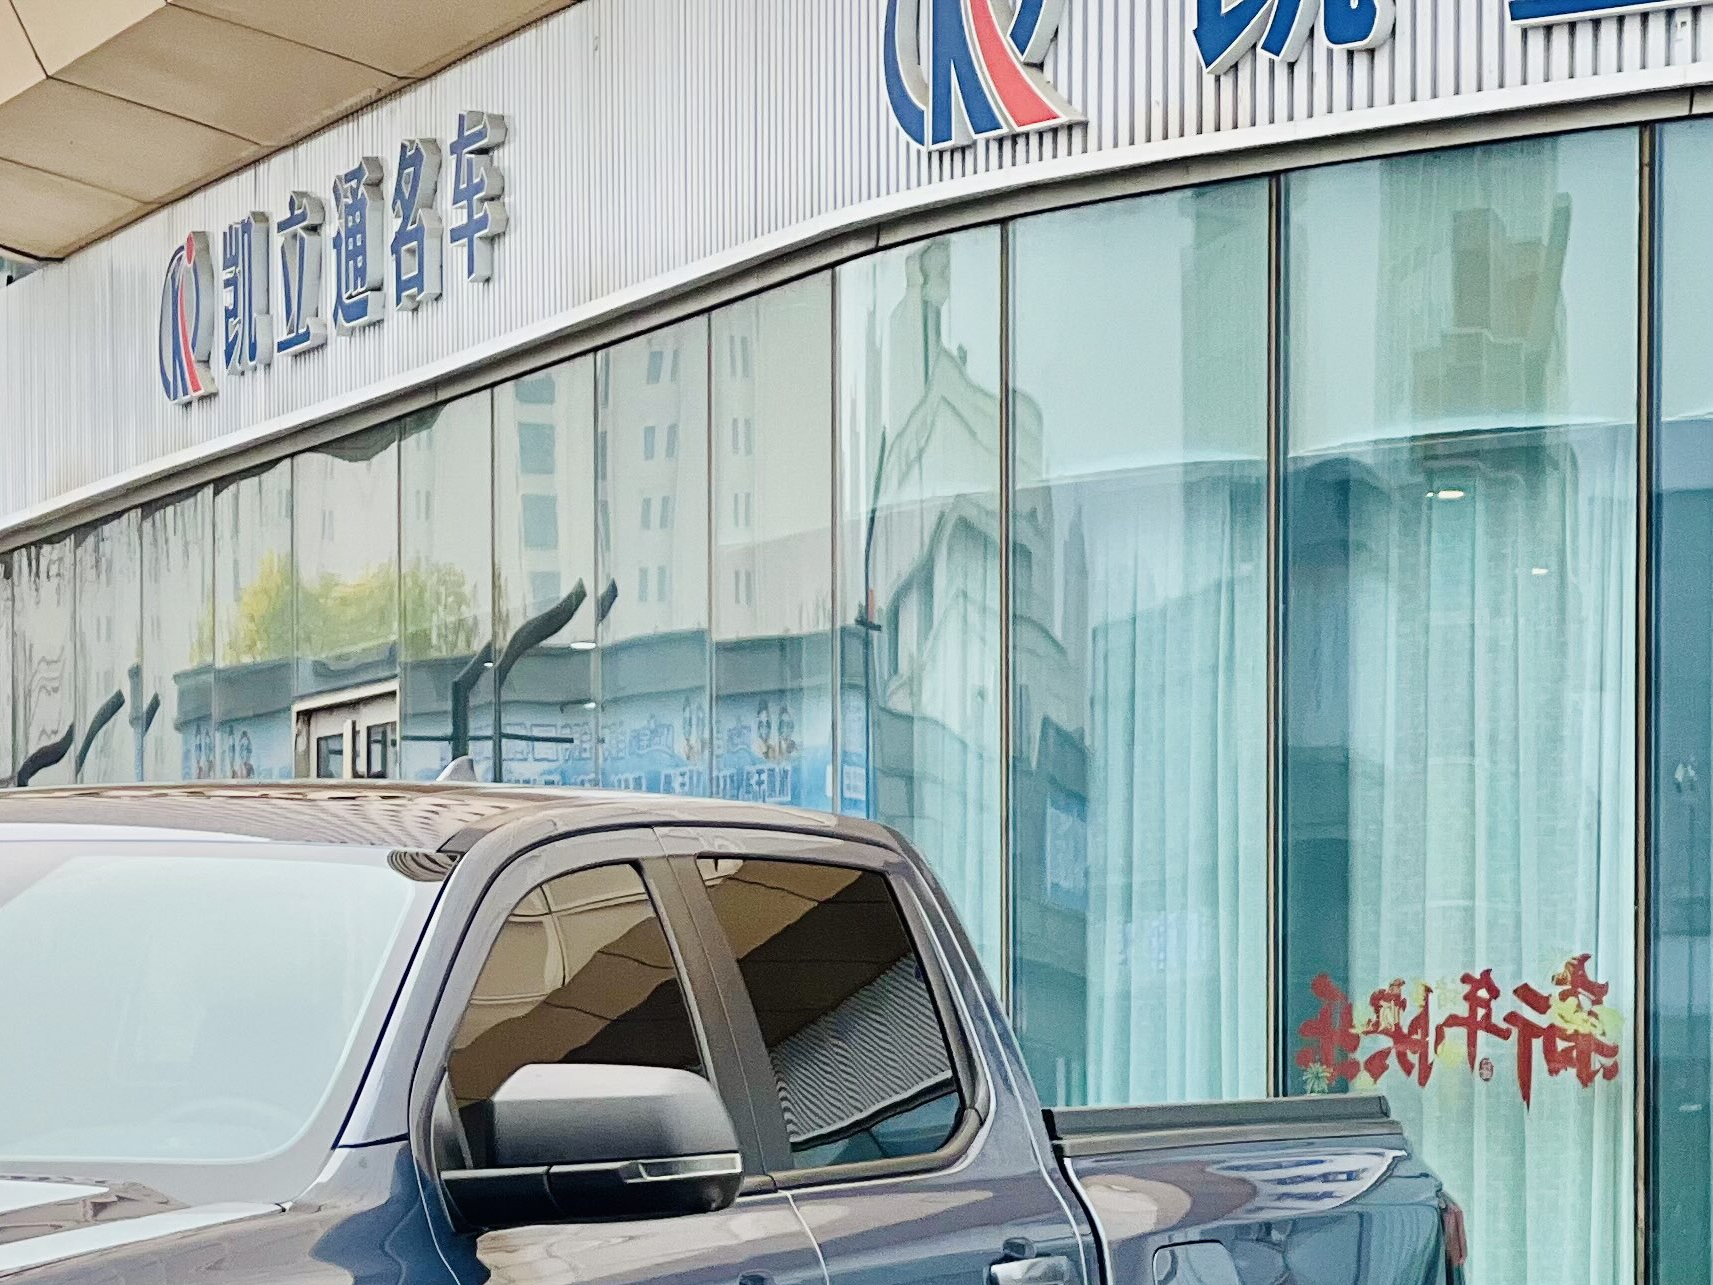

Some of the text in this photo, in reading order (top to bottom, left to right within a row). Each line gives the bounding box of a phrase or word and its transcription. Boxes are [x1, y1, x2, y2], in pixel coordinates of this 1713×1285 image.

[222, 110, 503, 376] 凯立通名车
